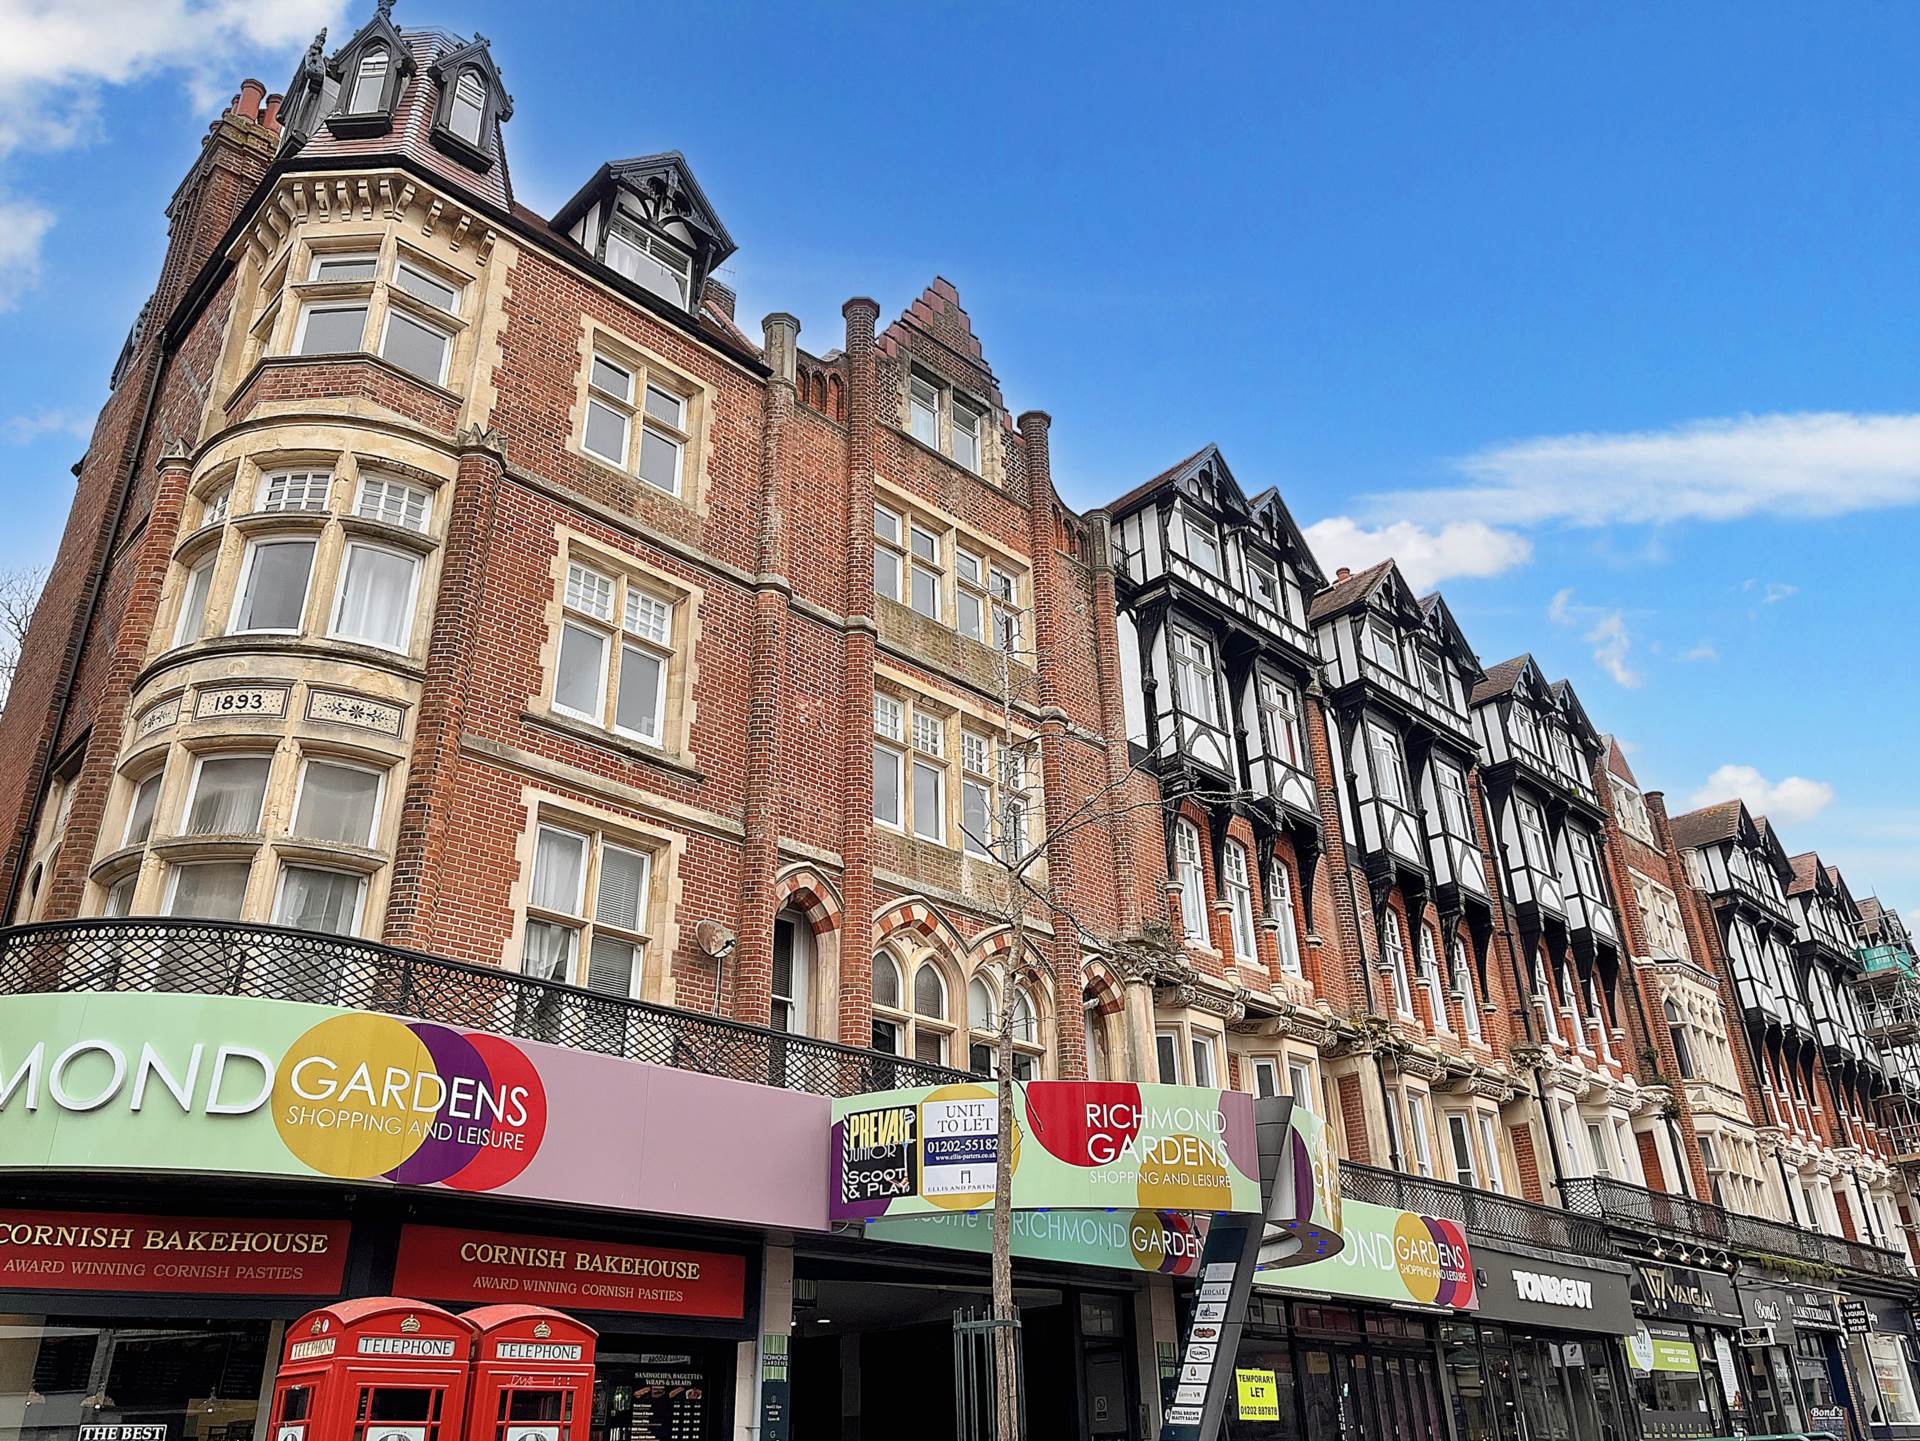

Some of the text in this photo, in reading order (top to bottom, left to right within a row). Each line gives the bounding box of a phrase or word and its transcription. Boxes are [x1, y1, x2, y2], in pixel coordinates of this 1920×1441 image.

[214, 694, 263, 711] 1893
[290, 1056, 529, 1127] GARDENS
[945, 1104, 985, 1118] UNIT
[1086, 1103, 1227, 1134] RICHMOND
[286, 1105, 526, 1151] SHOPPING AND LEISURE
[937, 1117, 994, 1132] TO LET
[848, 1143, 897, 1162] JUNIOR
[1087, 1133, 1229, 1168] GARDENS
[1090, 1170, 1232, 1188] SHOPPING AND LEISURE
[848, 1184, 861, 1199] &
[0, 1223, 329, 1254] CORNISH BAKEHOUSE
[1013, 1211, 1127, 1248] RICHMOND
[460, 1242, 700, 1280] CORNISH BAKEHOUSE
[1396, 1235, 1465, 1270] GARDENS
[3, 1259, 304, 1280] AWARD WINNING CORNISH PASTIES
[1400, 1263, 1468, 1283] SHOPPING AND LEISURE
[472, 1276, 683, 1302] AWARD WINNING CORNISH PASTIES
[1511, 1269, 1593, 1309] TONI&GUY
[1754, 1298, 1782, 1321] Bond's
[1844, 1310, 1866, 1318] LIQUID
[361, 1338, 452, 1355] TELEPHONE
[499, 1344, 579, 1359] TELEPHONE
[1238, 1374, 1274, 1384] TEMPORARY
[1250, 1387, 1265, 1398] LET
[1240, 1405, 1257, 1415] 01202
[1810, 1406, 1844, 1417] Bond's
[82, 1427, 164, 1440] THE BEST
